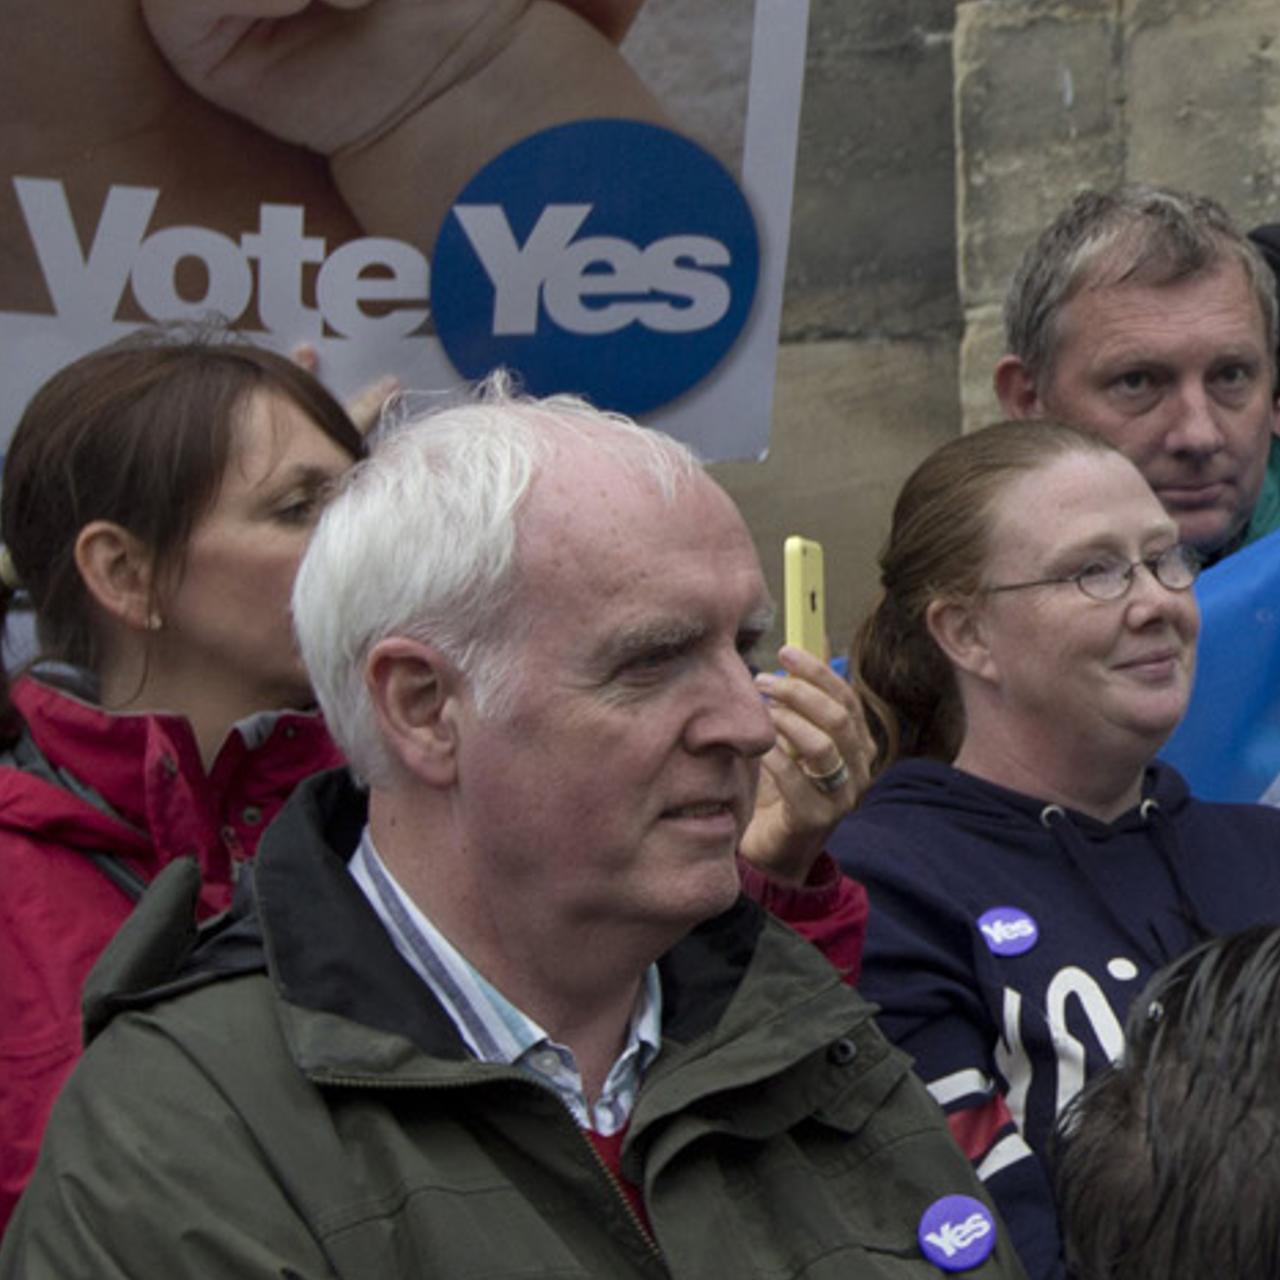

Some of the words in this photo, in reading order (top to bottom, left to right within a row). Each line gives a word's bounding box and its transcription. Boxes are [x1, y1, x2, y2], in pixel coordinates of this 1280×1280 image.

[13, 175, 430, 340] Vote
[453, 202, 732, 336] Yes
[980, 917, 1036, 944] Yes
[924, 1212, 991, 1258] Yes
